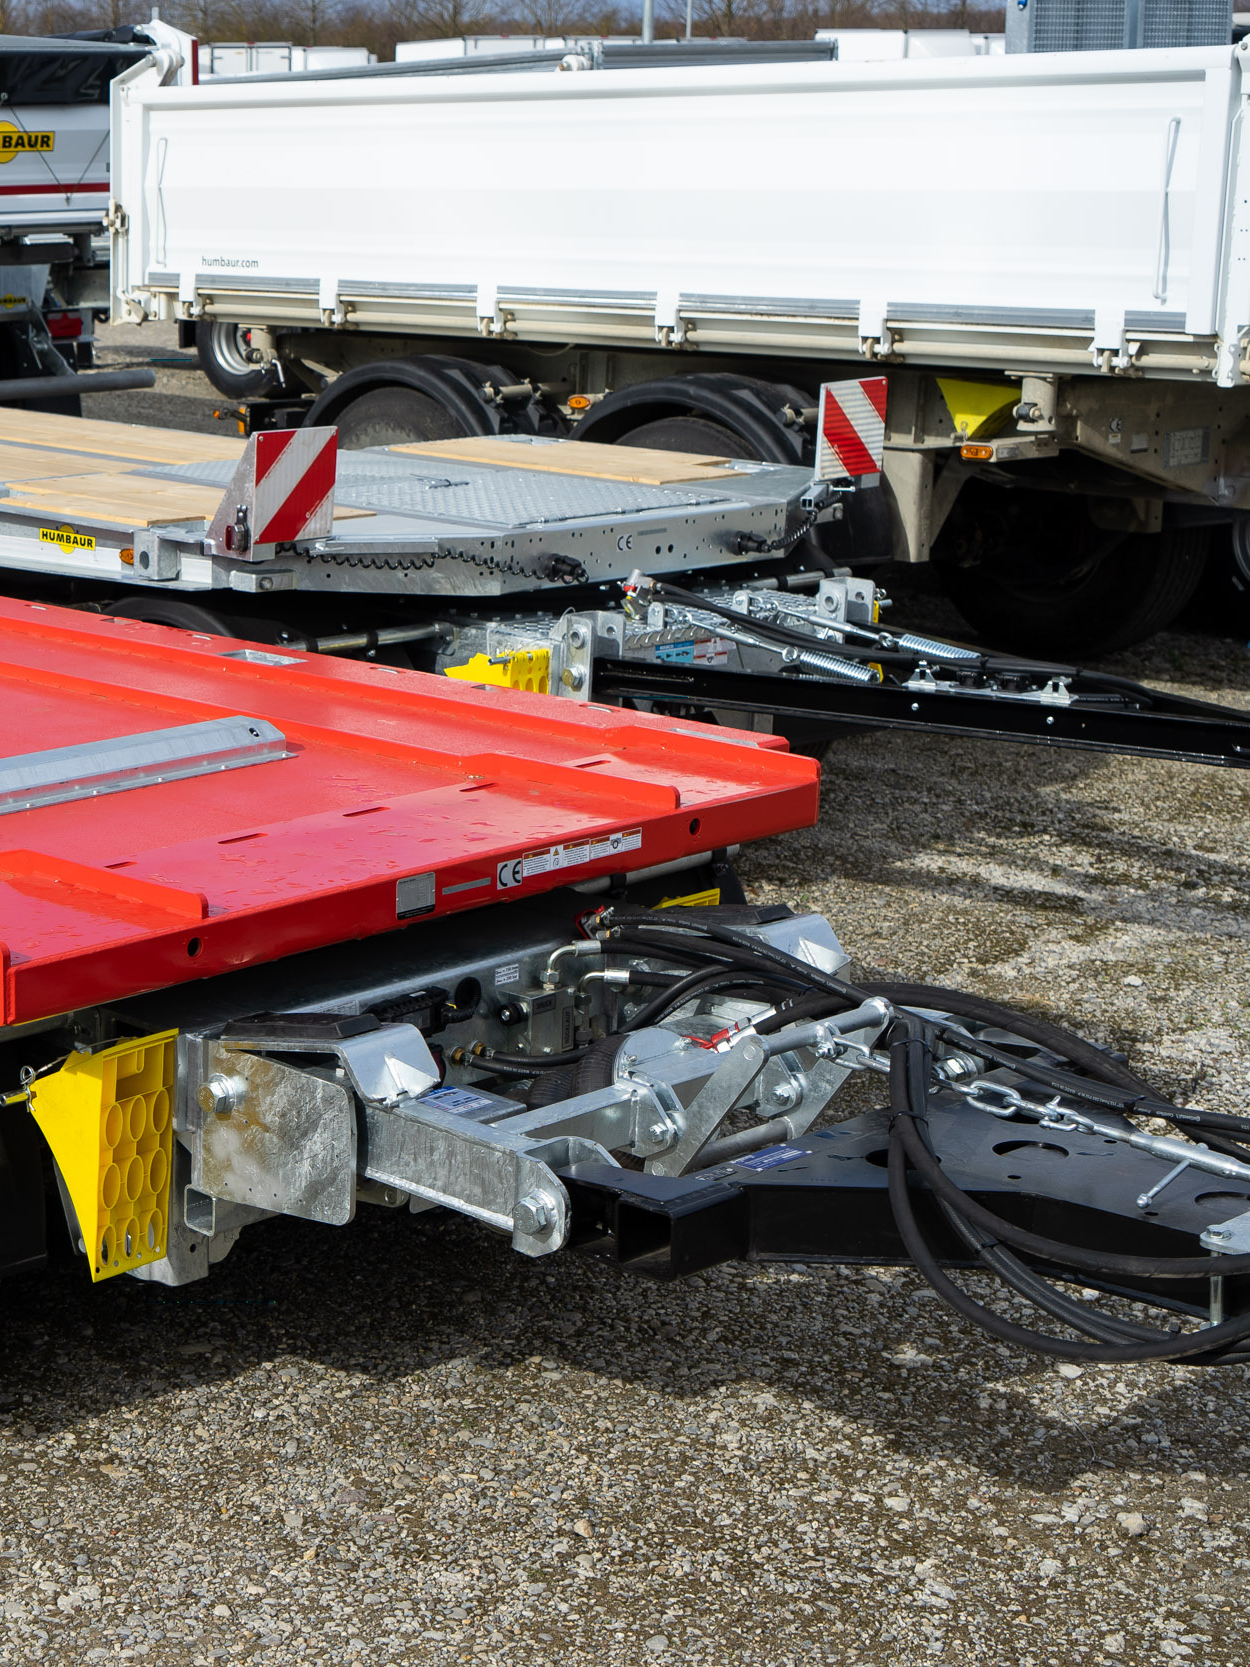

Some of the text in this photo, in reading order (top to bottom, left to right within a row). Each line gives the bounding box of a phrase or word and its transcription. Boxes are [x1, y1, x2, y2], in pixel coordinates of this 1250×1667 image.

[201, 255, 259, 268] humbaur.com
[41, 530, 93, 548] HUMBAUR
[617, 534, 633, 551] CE
[498, 860, 522, 887] CE
